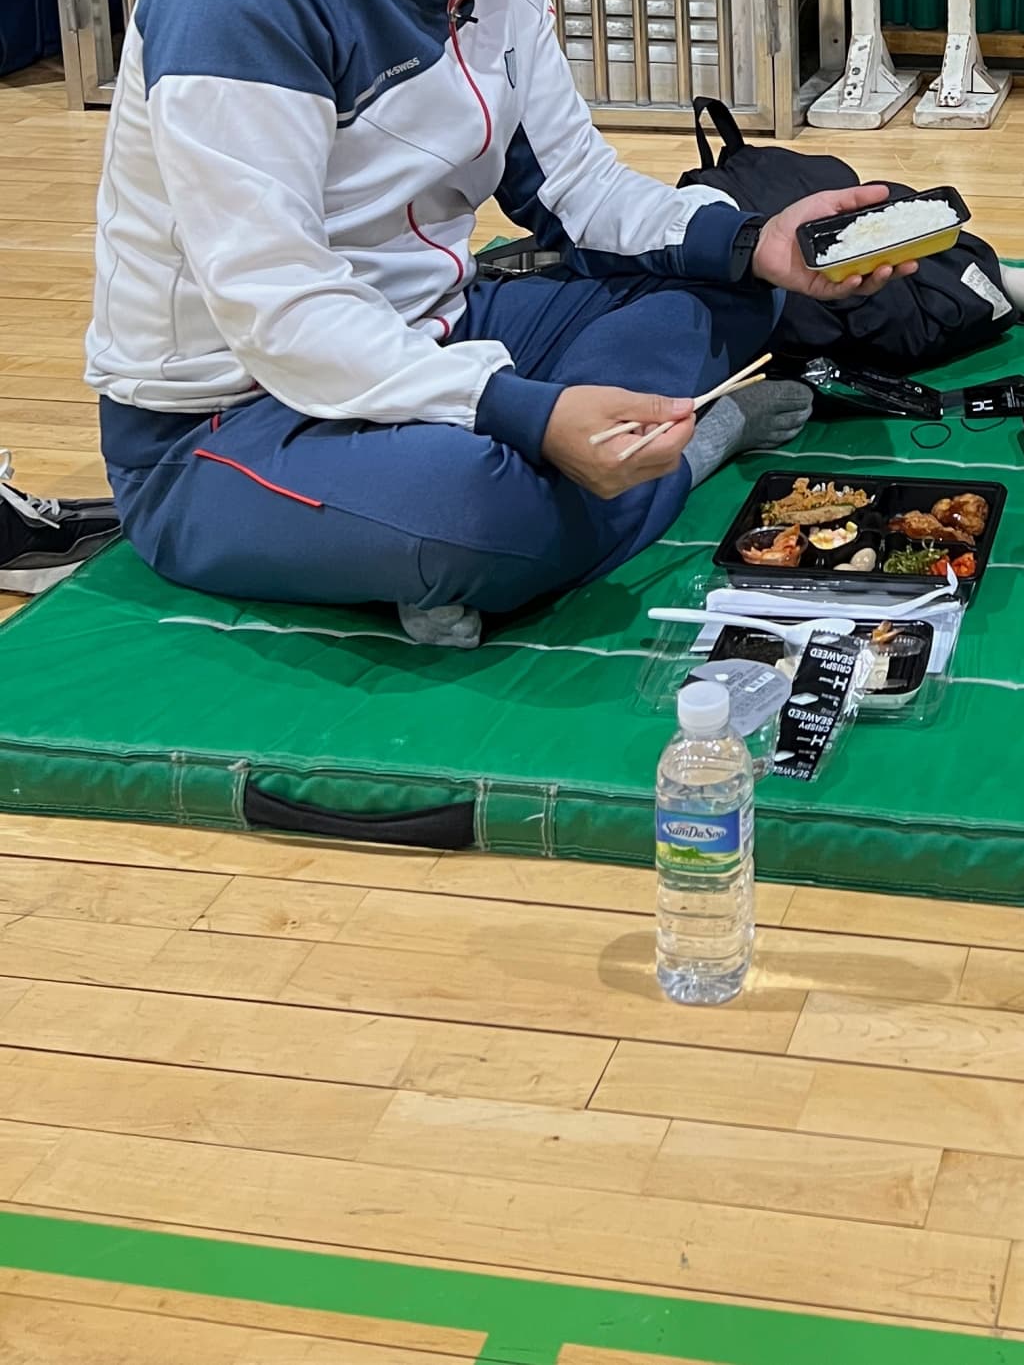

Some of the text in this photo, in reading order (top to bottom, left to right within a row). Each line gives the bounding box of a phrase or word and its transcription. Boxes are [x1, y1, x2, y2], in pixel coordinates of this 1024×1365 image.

[386, 57, 420, 77] K-SWISS
[810, 647, 855, 664] SEAWEED
[820, 660, 852, 675] CRISPY
[788, 708, 834, 725] SEAWEED
[798, 721, 830, 733] CRISPY
